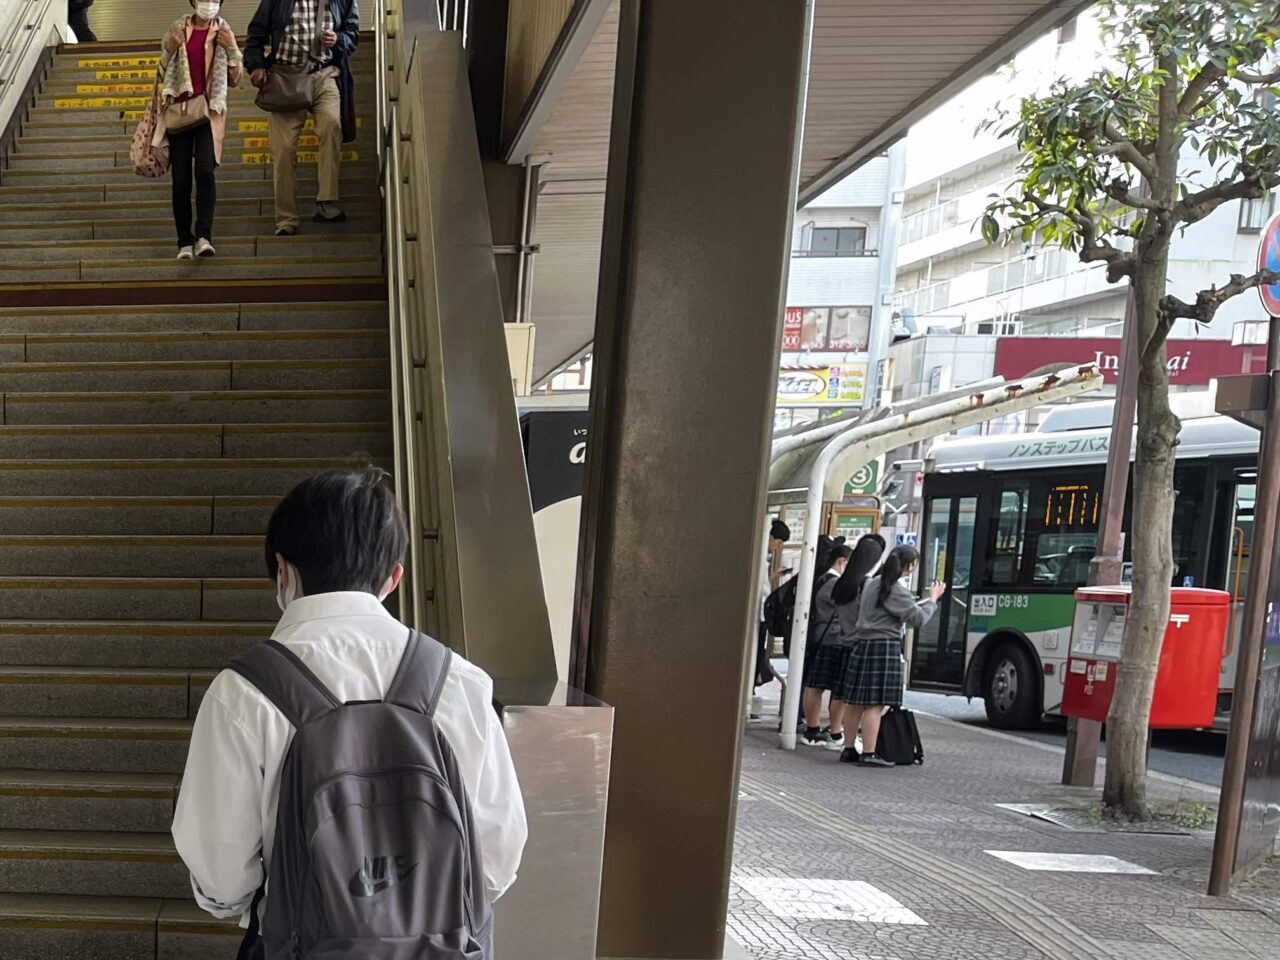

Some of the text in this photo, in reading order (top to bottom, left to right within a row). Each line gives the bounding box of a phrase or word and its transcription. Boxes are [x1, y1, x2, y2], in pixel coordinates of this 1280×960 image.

[1008, 436, 1108, 458] ノンステップバス
